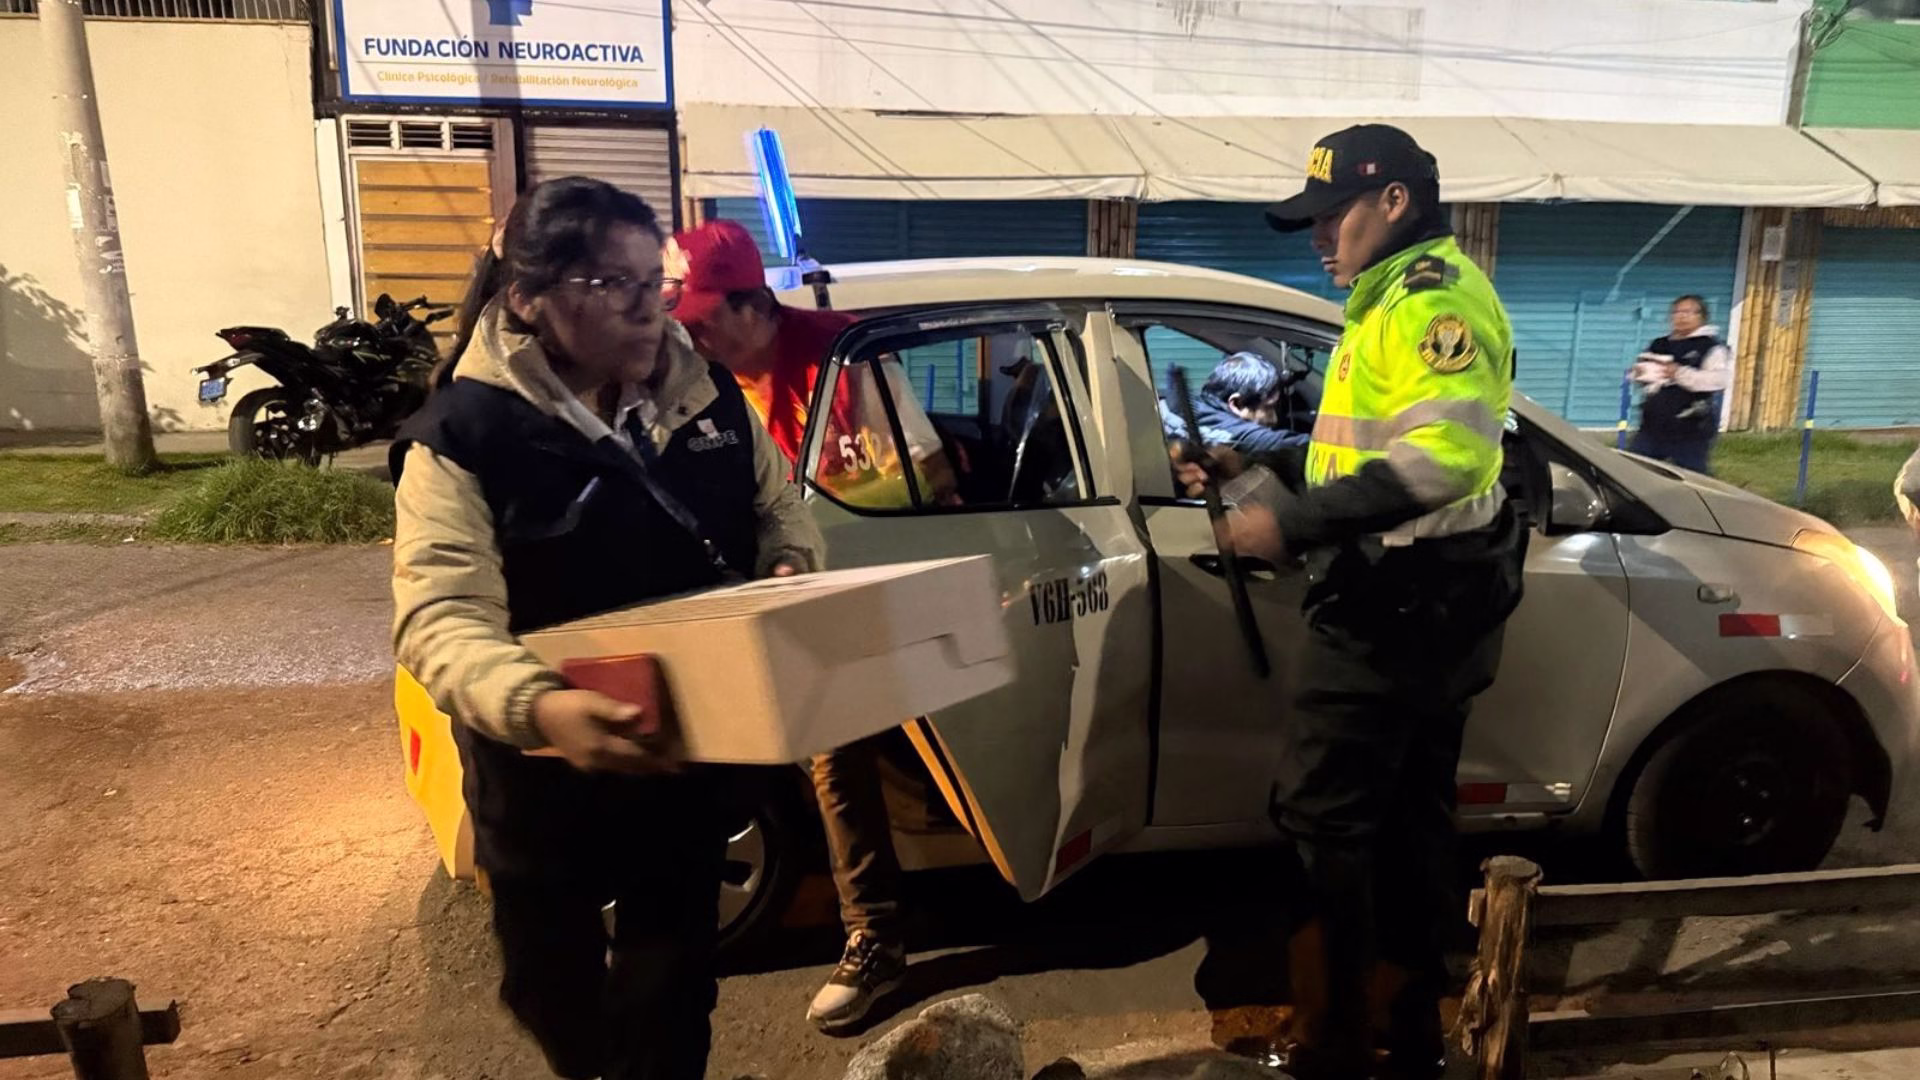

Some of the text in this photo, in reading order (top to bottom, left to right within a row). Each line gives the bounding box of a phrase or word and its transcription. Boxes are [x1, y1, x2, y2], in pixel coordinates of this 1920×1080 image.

[364, 35, 644, 63] FUNDACIÓN NEUROACTIVA
[572, 75, 638, 89] Neurológica
